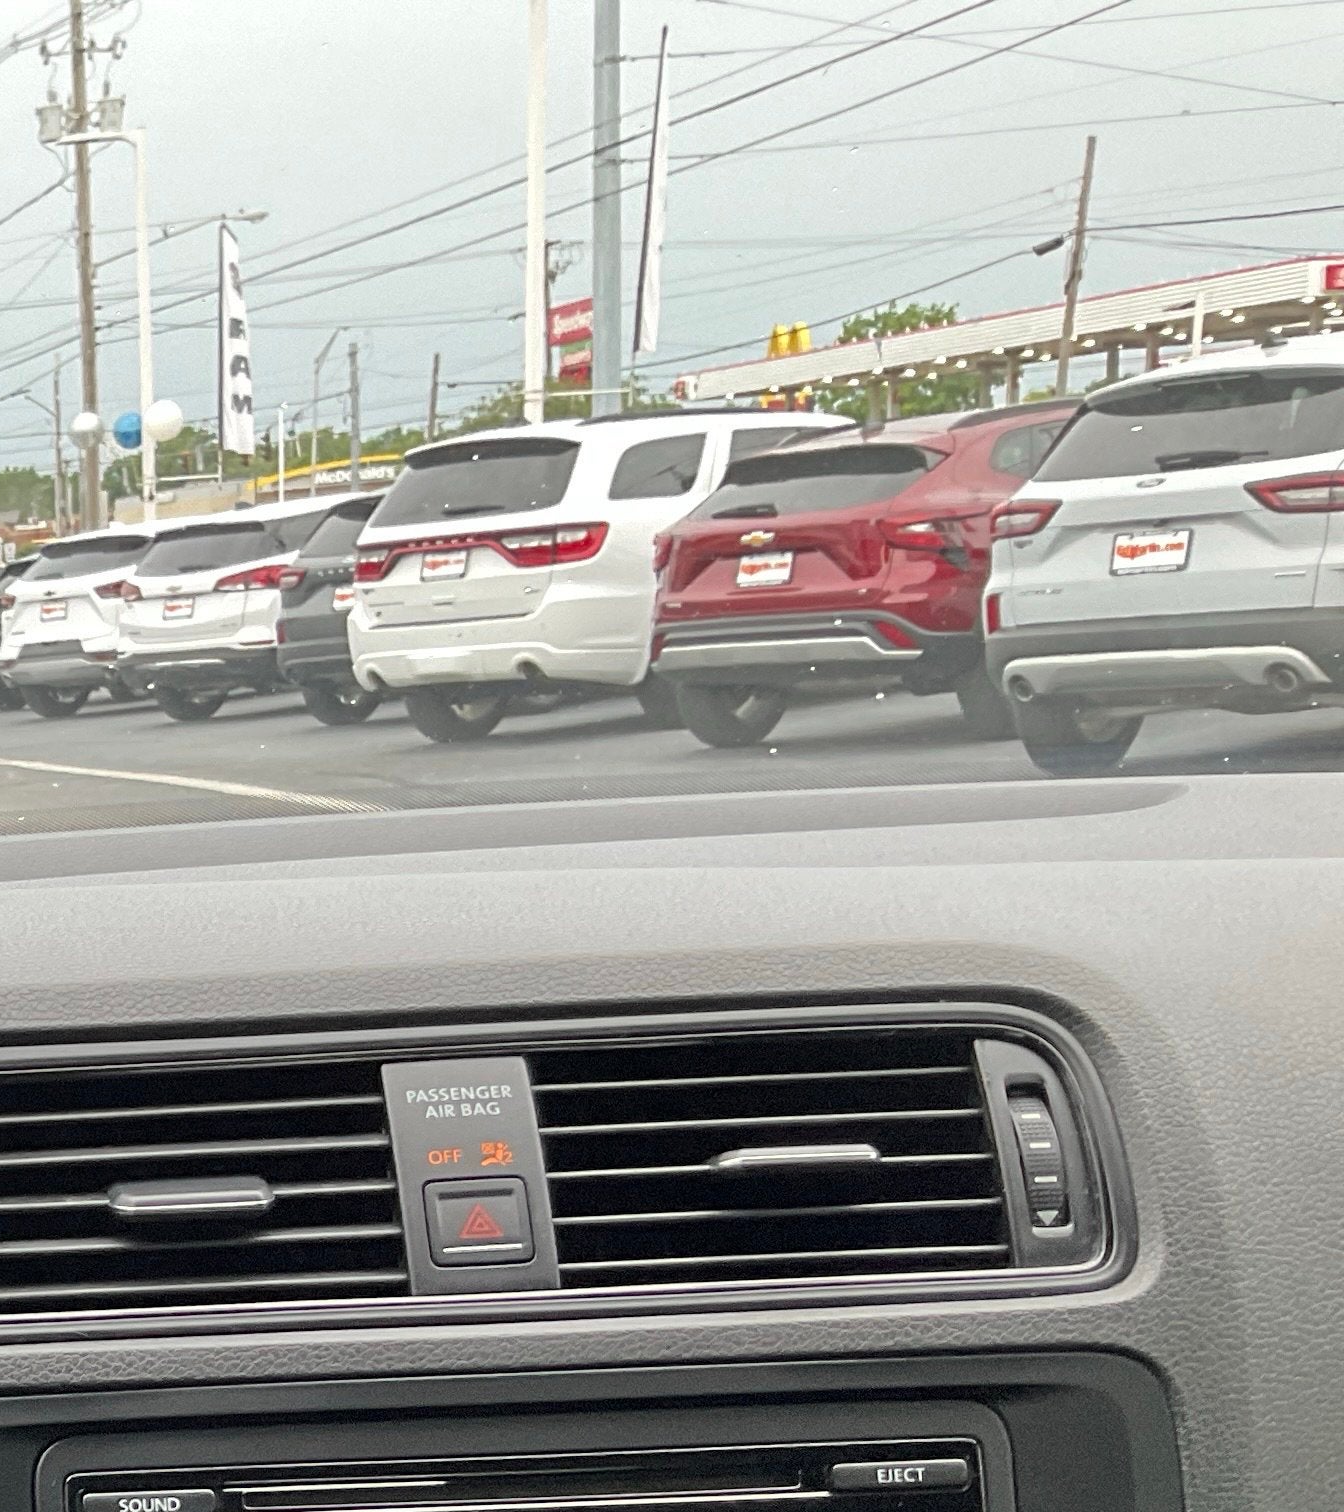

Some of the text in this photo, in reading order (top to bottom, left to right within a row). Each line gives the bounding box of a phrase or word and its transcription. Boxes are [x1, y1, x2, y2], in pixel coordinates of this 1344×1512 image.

[405, 1085, 513, 1104] PASSENGER
[425, 1102, 501, 1119] AIR BAG
[427, 1148, 462, 1165] OFF
[876, 1466, 927, 1483] EJECT
